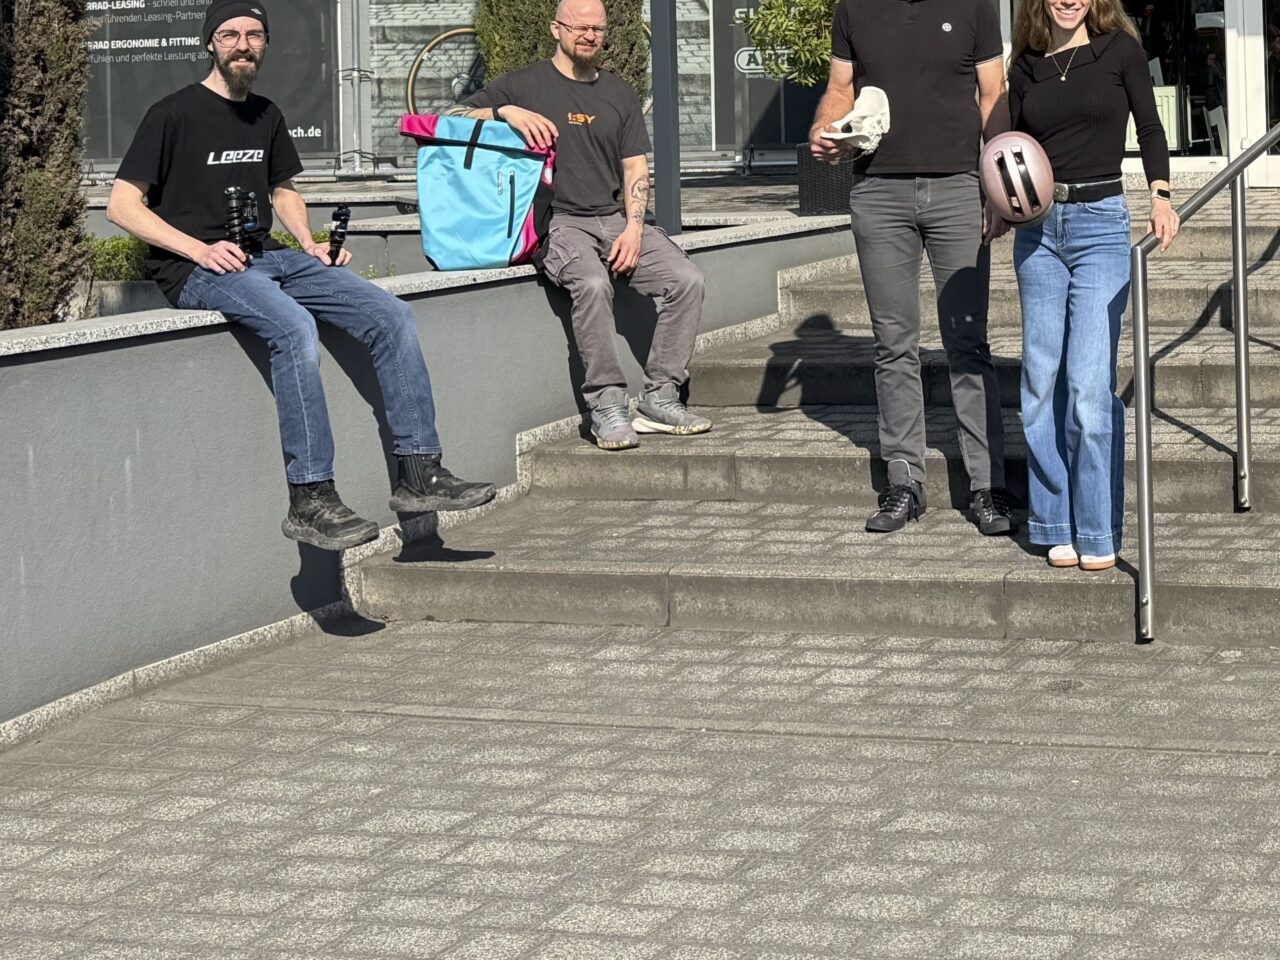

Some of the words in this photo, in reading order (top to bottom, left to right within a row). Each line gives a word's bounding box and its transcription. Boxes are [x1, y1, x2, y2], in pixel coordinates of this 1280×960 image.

[86, 0, 146, 11] RRAD-LEASING
[111, 38, 159, 49] ERGONOMIE
[160, 37, 168, 47] &
[169, 36, 200, 47] FITTING
[131, 52, 163, 64] perfekte
[164, 51, 196, 63] Leistung
